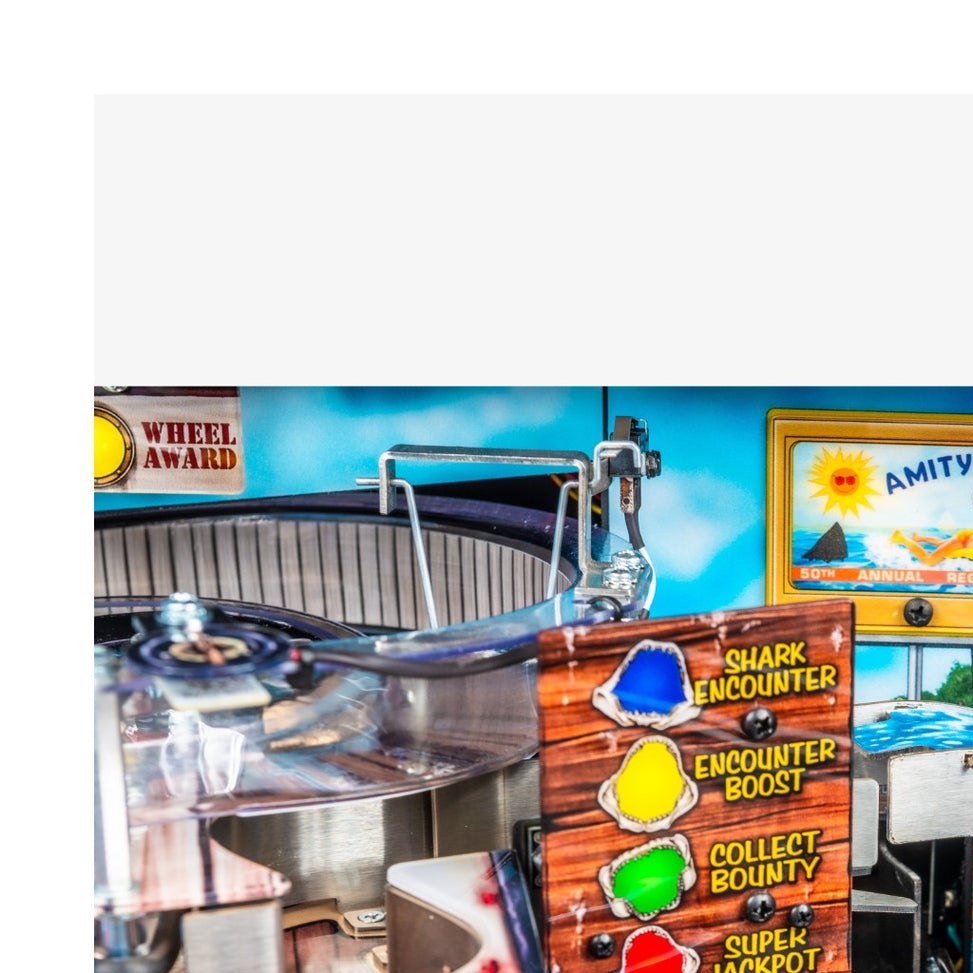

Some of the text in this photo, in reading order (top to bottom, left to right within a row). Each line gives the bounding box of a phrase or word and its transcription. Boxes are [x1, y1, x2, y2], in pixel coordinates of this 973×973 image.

[141, 421, 237, 445] WHEEL
[143, 446, 237, 470] AWARD
[886, 453, 972, 495] AMITY
[801, 567, 836, 580] 50TH
[857, 569, 924, 582] ANNUAL
[724, 641, 807, 674] SHARK
[694, 664, 836, 705] ENCOUNTER
[694, 738, 836, 779] ENCOUNTER
[725, 768, 806, 801] BOOST
[709, 830, 821, 867] COLLECT
[711, 856, 820, 893] BOUNTY
[724, 926, 807, 959] SUPER
